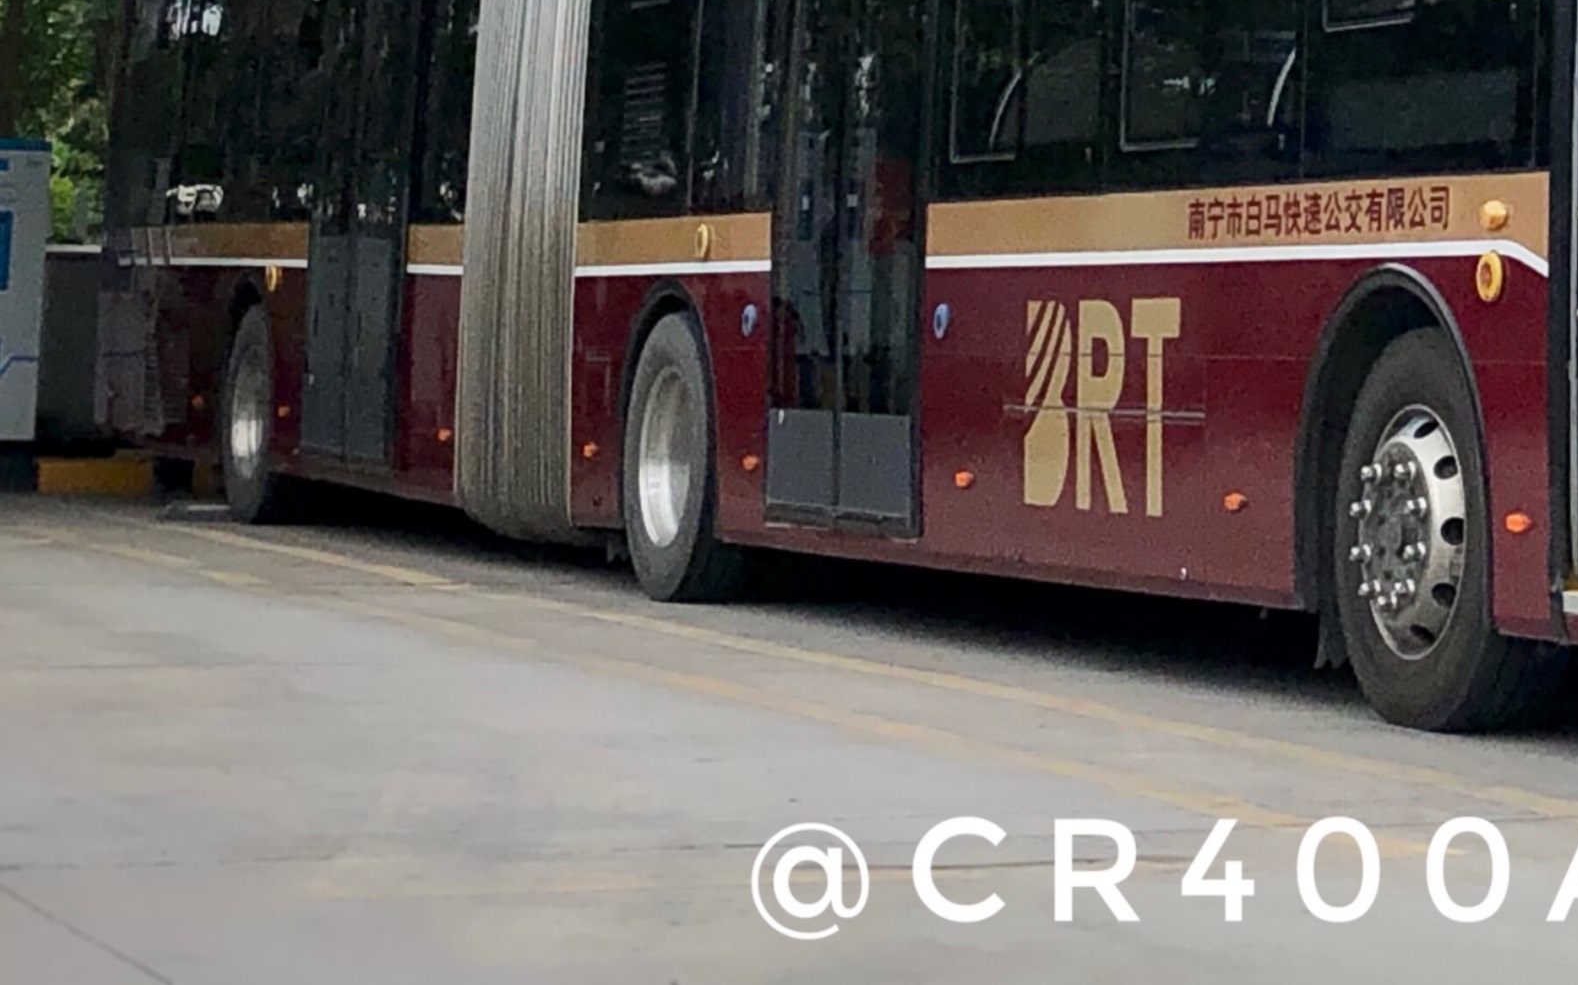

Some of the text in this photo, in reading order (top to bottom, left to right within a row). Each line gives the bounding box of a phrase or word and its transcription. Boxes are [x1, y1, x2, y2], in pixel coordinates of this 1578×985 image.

[1187, 185, 1450, 240] 南宁市白马快速公交有限公司
